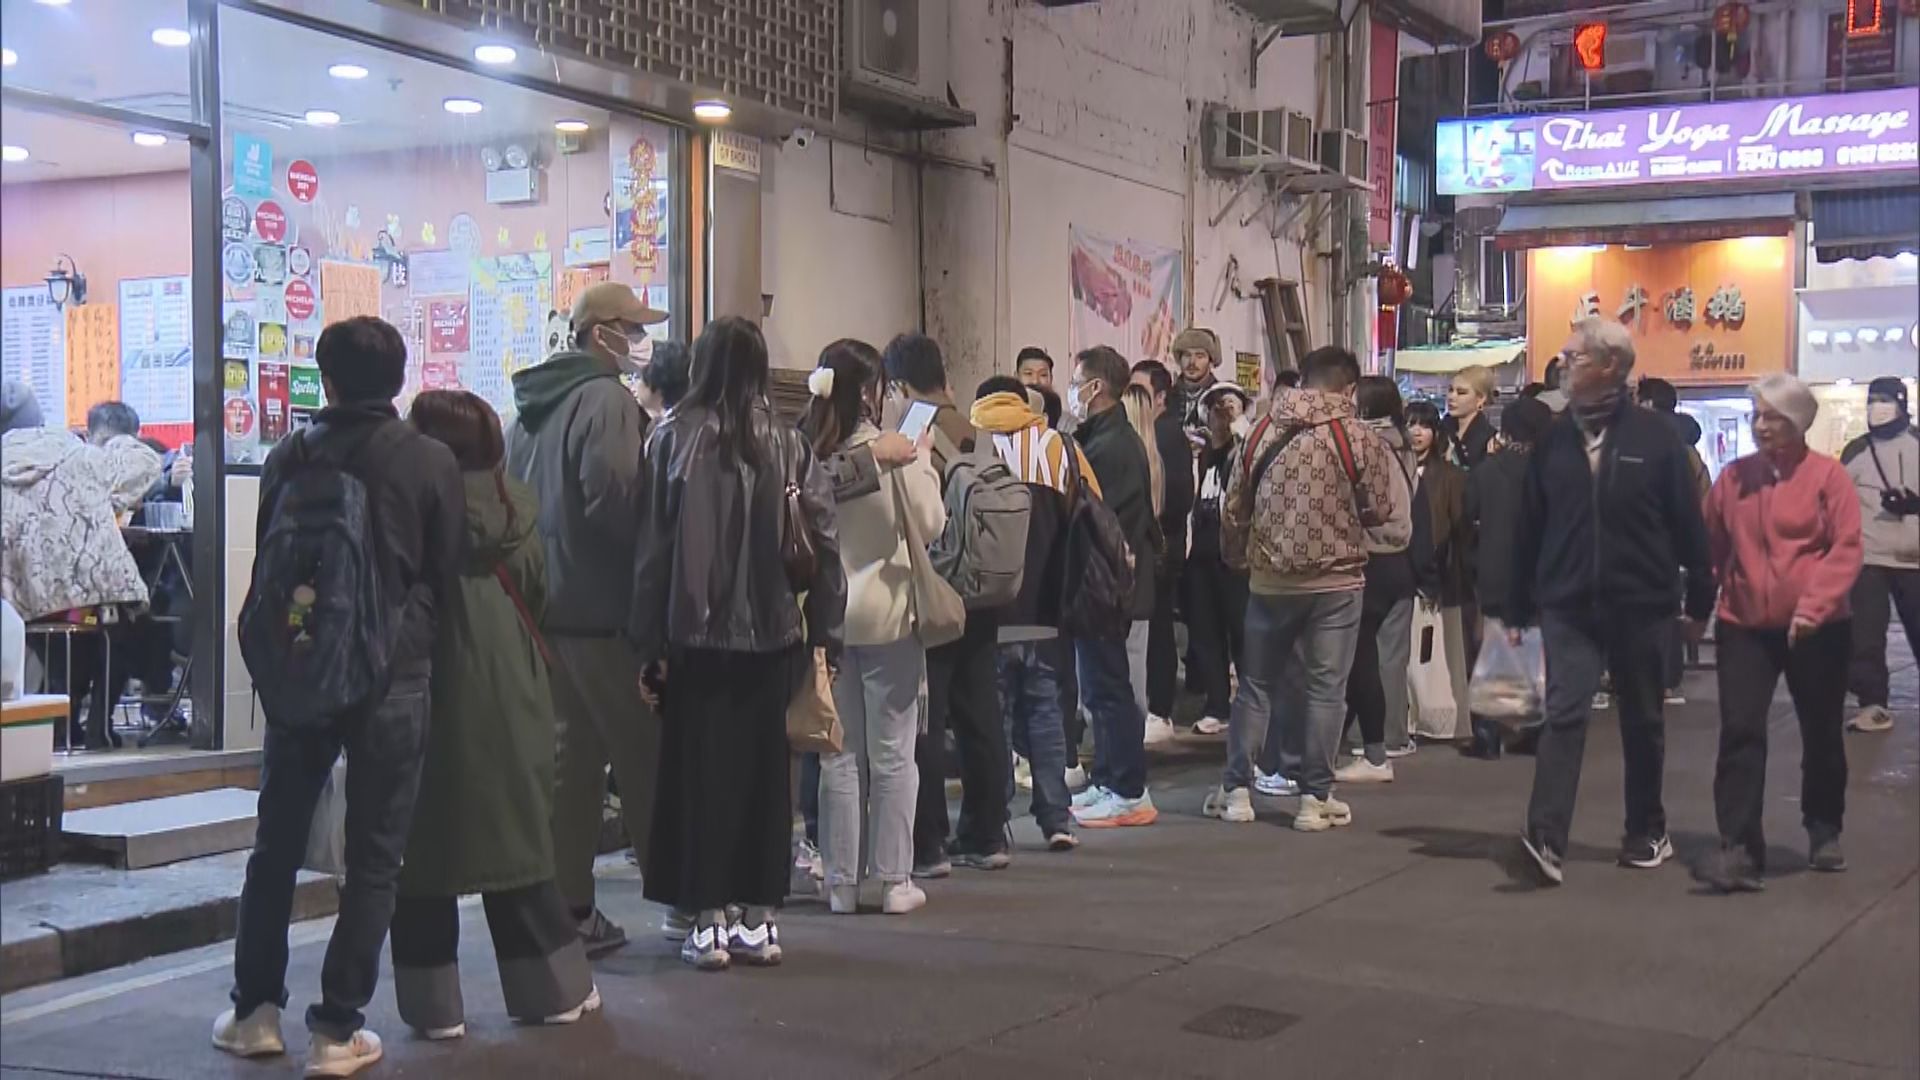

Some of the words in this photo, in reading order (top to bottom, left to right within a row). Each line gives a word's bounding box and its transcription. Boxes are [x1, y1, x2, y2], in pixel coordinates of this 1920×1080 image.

[1542, 118, 1627, 151] Thai
[1638, 110, 1731, 153] Yoga
[1739, 102, 1909, 144] Massage
[291, 379, 320, 396] Sprite
